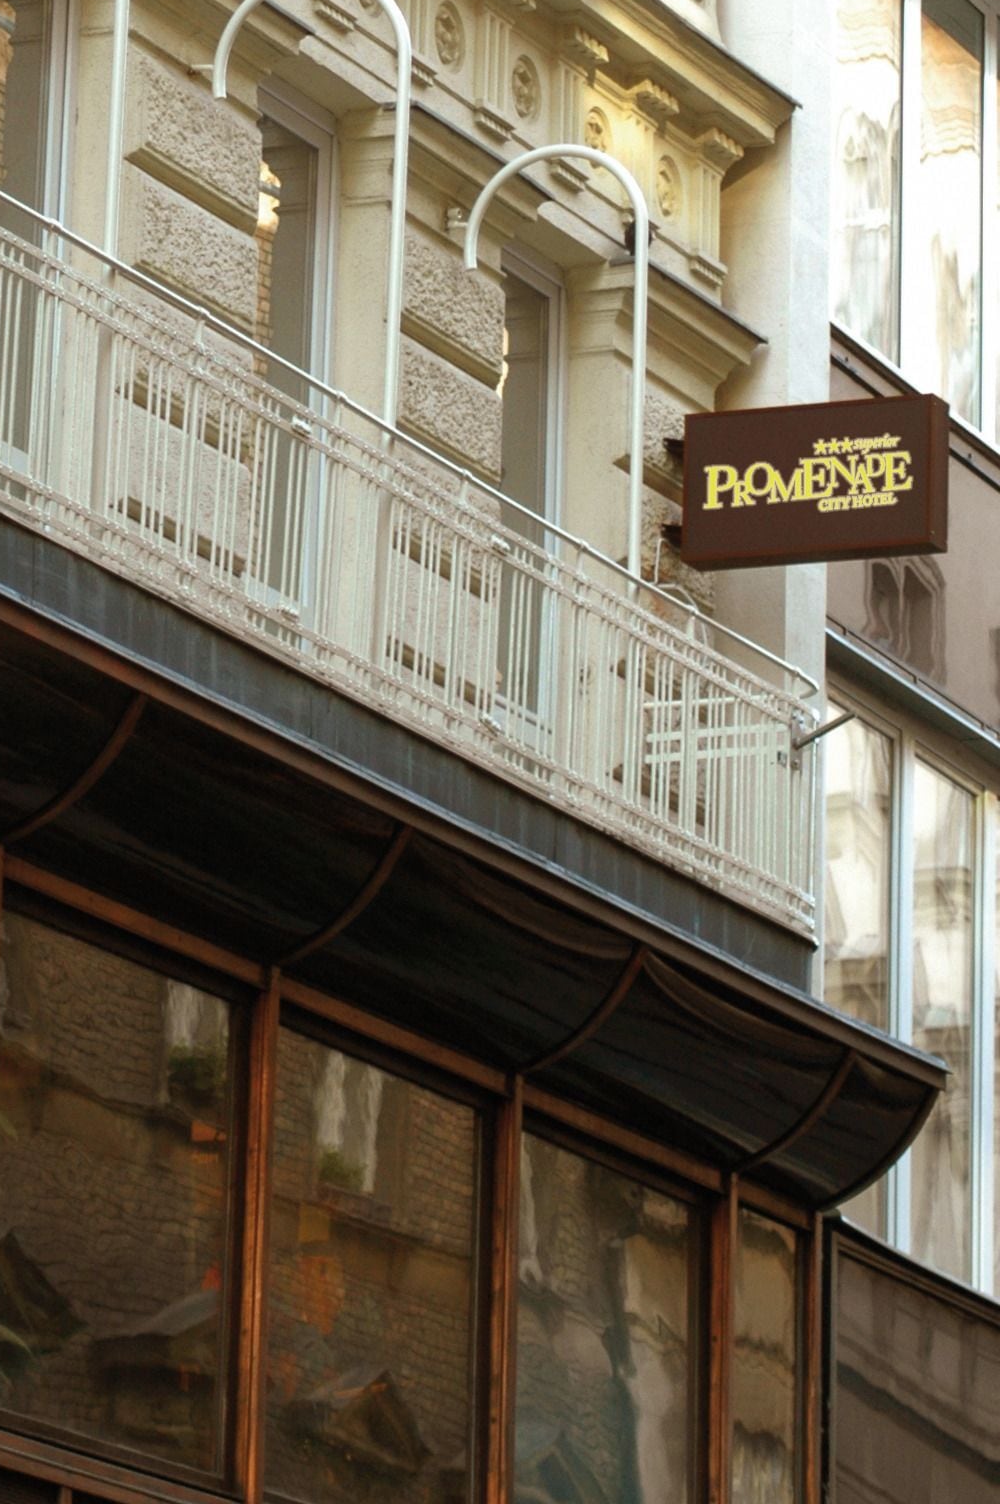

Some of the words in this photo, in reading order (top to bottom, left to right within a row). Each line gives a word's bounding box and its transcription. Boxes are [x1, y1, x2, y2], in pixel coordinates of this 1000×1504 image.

[702, 450, 914, 510] PROMENADE
[817, 495, 851, 513] CITY
[851, 492, 898, 509] HOTEL
